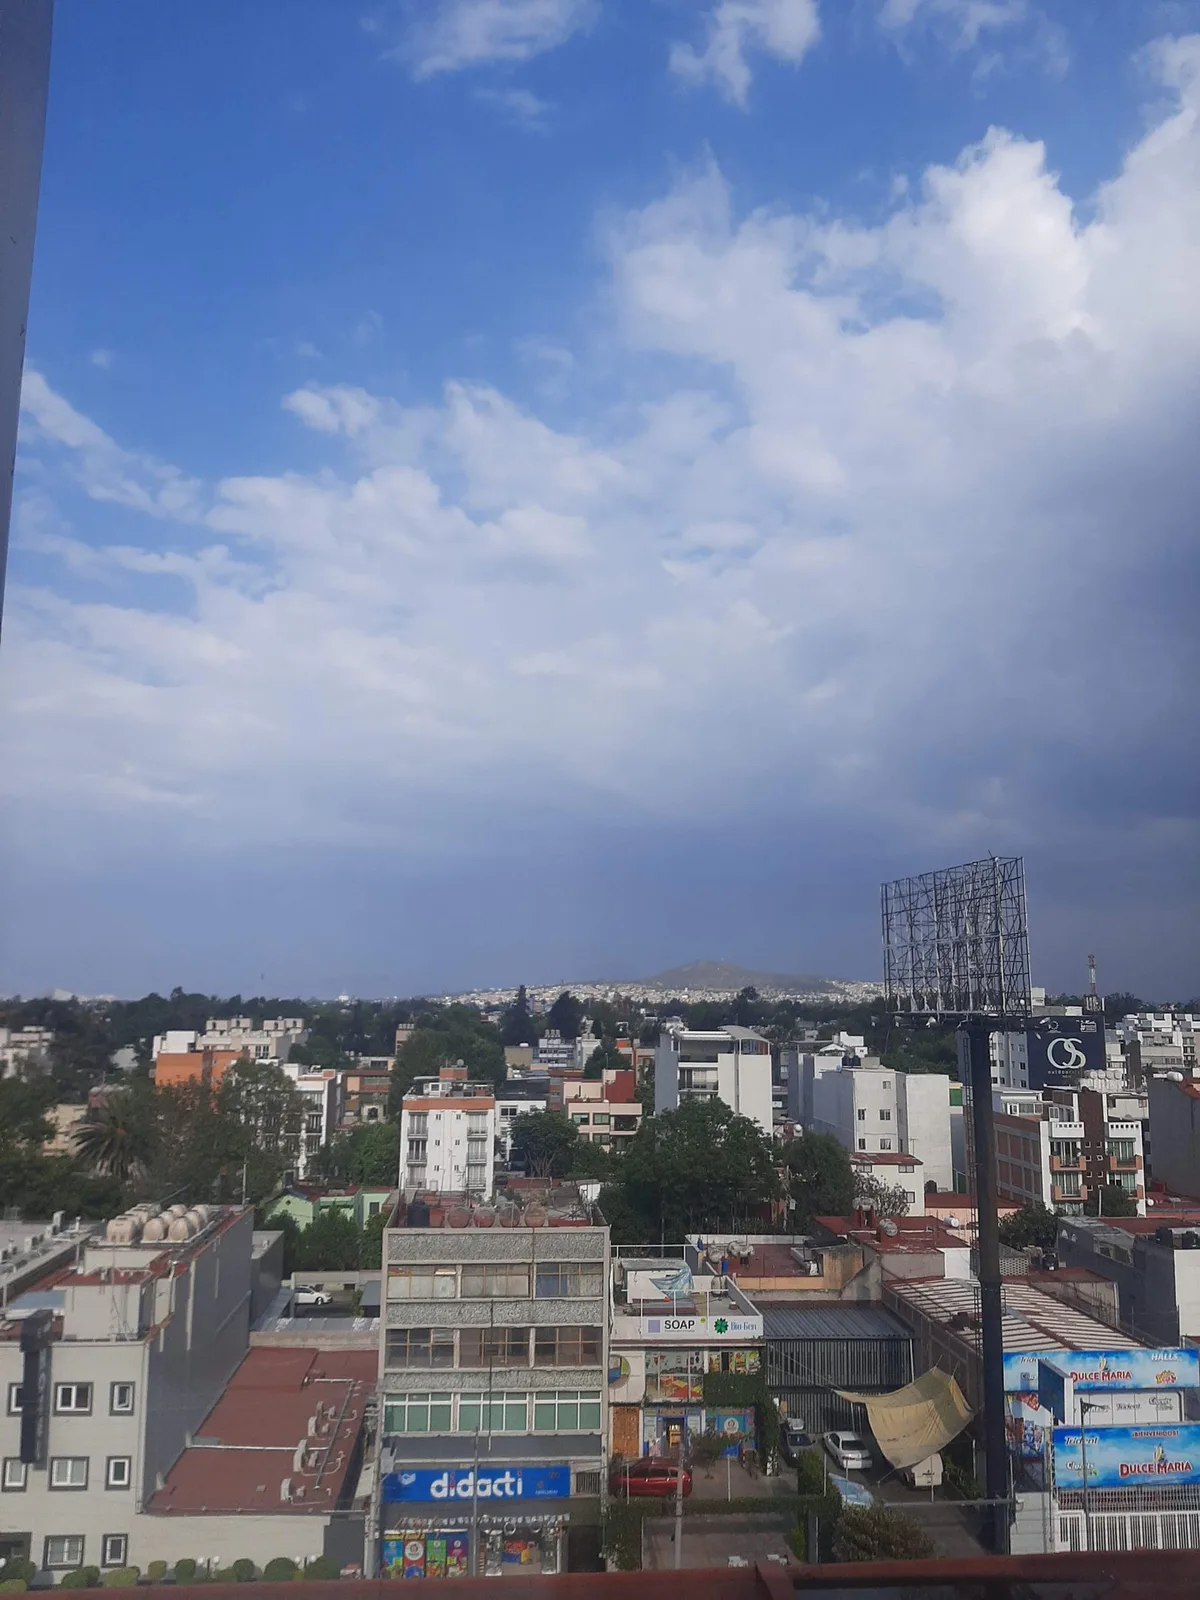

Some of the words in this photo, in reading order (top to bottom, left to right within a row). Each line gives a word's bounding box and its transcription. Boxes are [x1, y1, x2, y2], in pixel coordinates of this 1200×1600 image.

[664, 1319, 695, 1330] SOAP
[1151, 1353, 1178, 1361] HALLS
[1069, 1371, 1100, 1383] DULCE
[1101, 1370, 1132, 1381] MARIA
[1119, 1462, 1154, 1477] DULCE
[1156, 1461, 1192, 1475] MARIA
[430, 1470, 523, 1498] didacti
